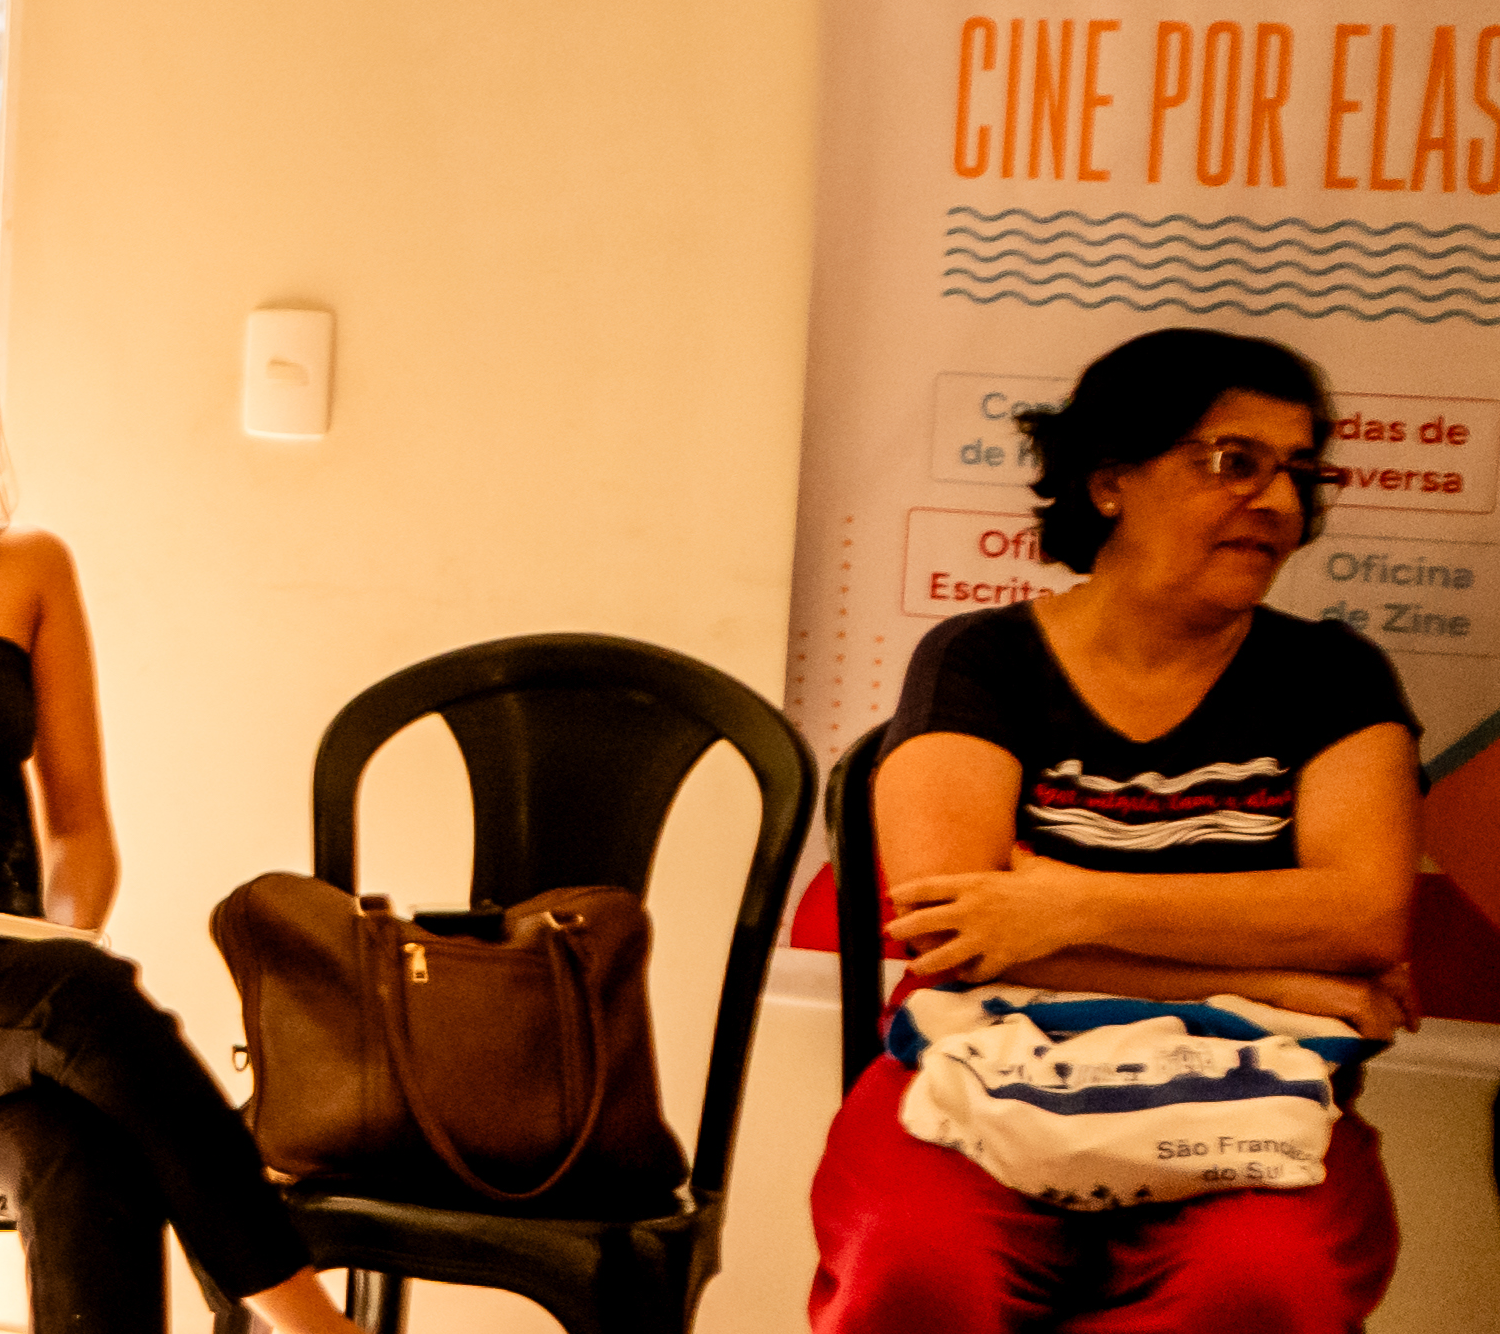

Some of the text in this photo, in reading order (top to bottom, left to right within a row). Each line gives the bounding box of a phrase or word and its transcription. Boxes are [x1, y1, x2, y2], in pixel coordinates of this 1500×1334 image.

[953, 16, 1500, 196] CINE POR ELAS
[1334, 411, 1471, 446] das de
[960, 438, 1006, 466] de
[1327, 551, 1476, 590] Oficina
[1381, 602, 1472, 638] Zine
[1156, 1138, 1209, 1160] São
[1201, 1164, 1237, 1182] do
